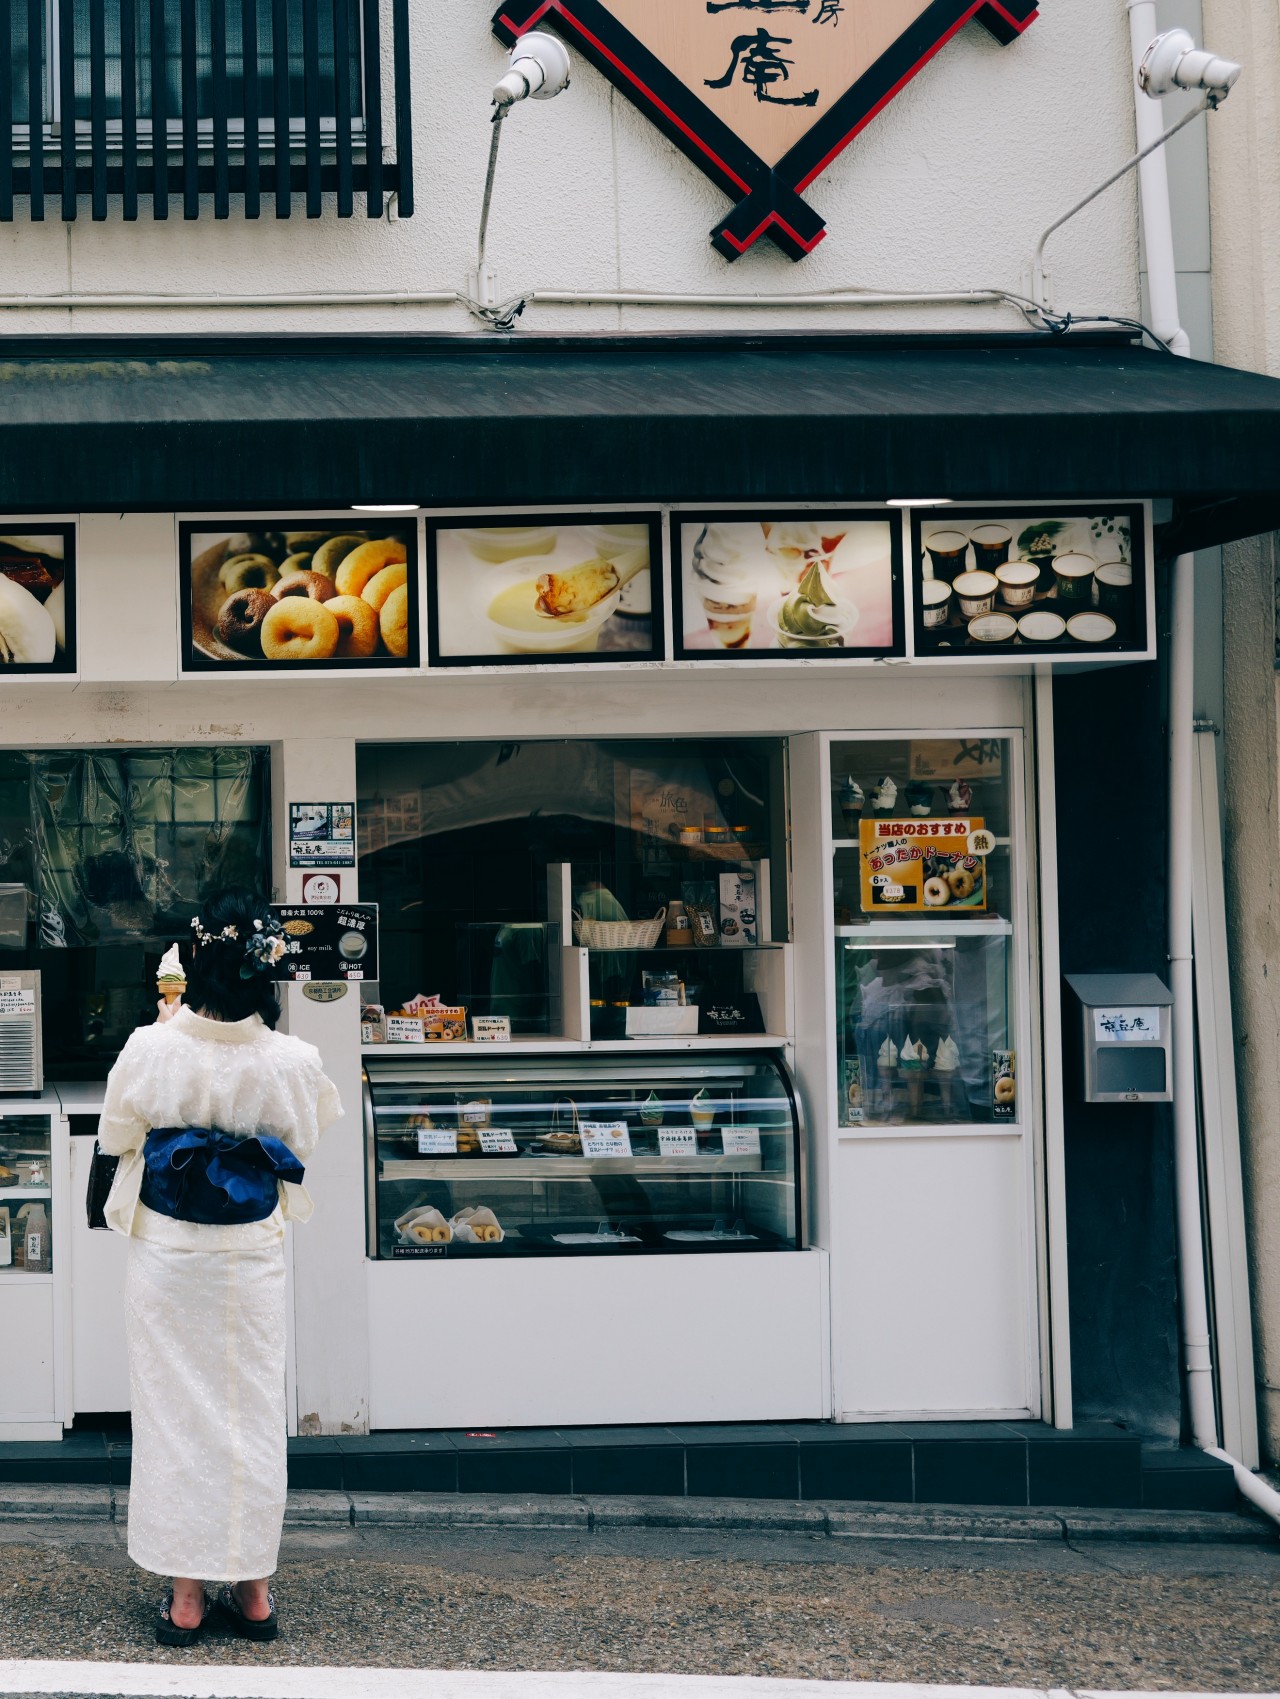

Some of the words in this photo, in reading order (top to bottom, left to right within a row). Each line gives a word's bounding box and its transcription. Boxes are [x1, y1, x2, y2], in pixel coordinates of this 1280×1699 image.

[660, 791, 689, 813] 旅色
[878, 823, 967, 837] 当店のおすすめ
[863, 838, 908, 859] ドーナツ職人の
[973, 835, 989, 850] 熱
[868, 846, 978, 871] あったかドーナツ
[885, 887, 901, 895] ¥378
[337, 915, 366, 931] 超濃厚
[409, 997, 437, 1015] HOT
[1100, 1017, 1150, 1033] 京豆庵
